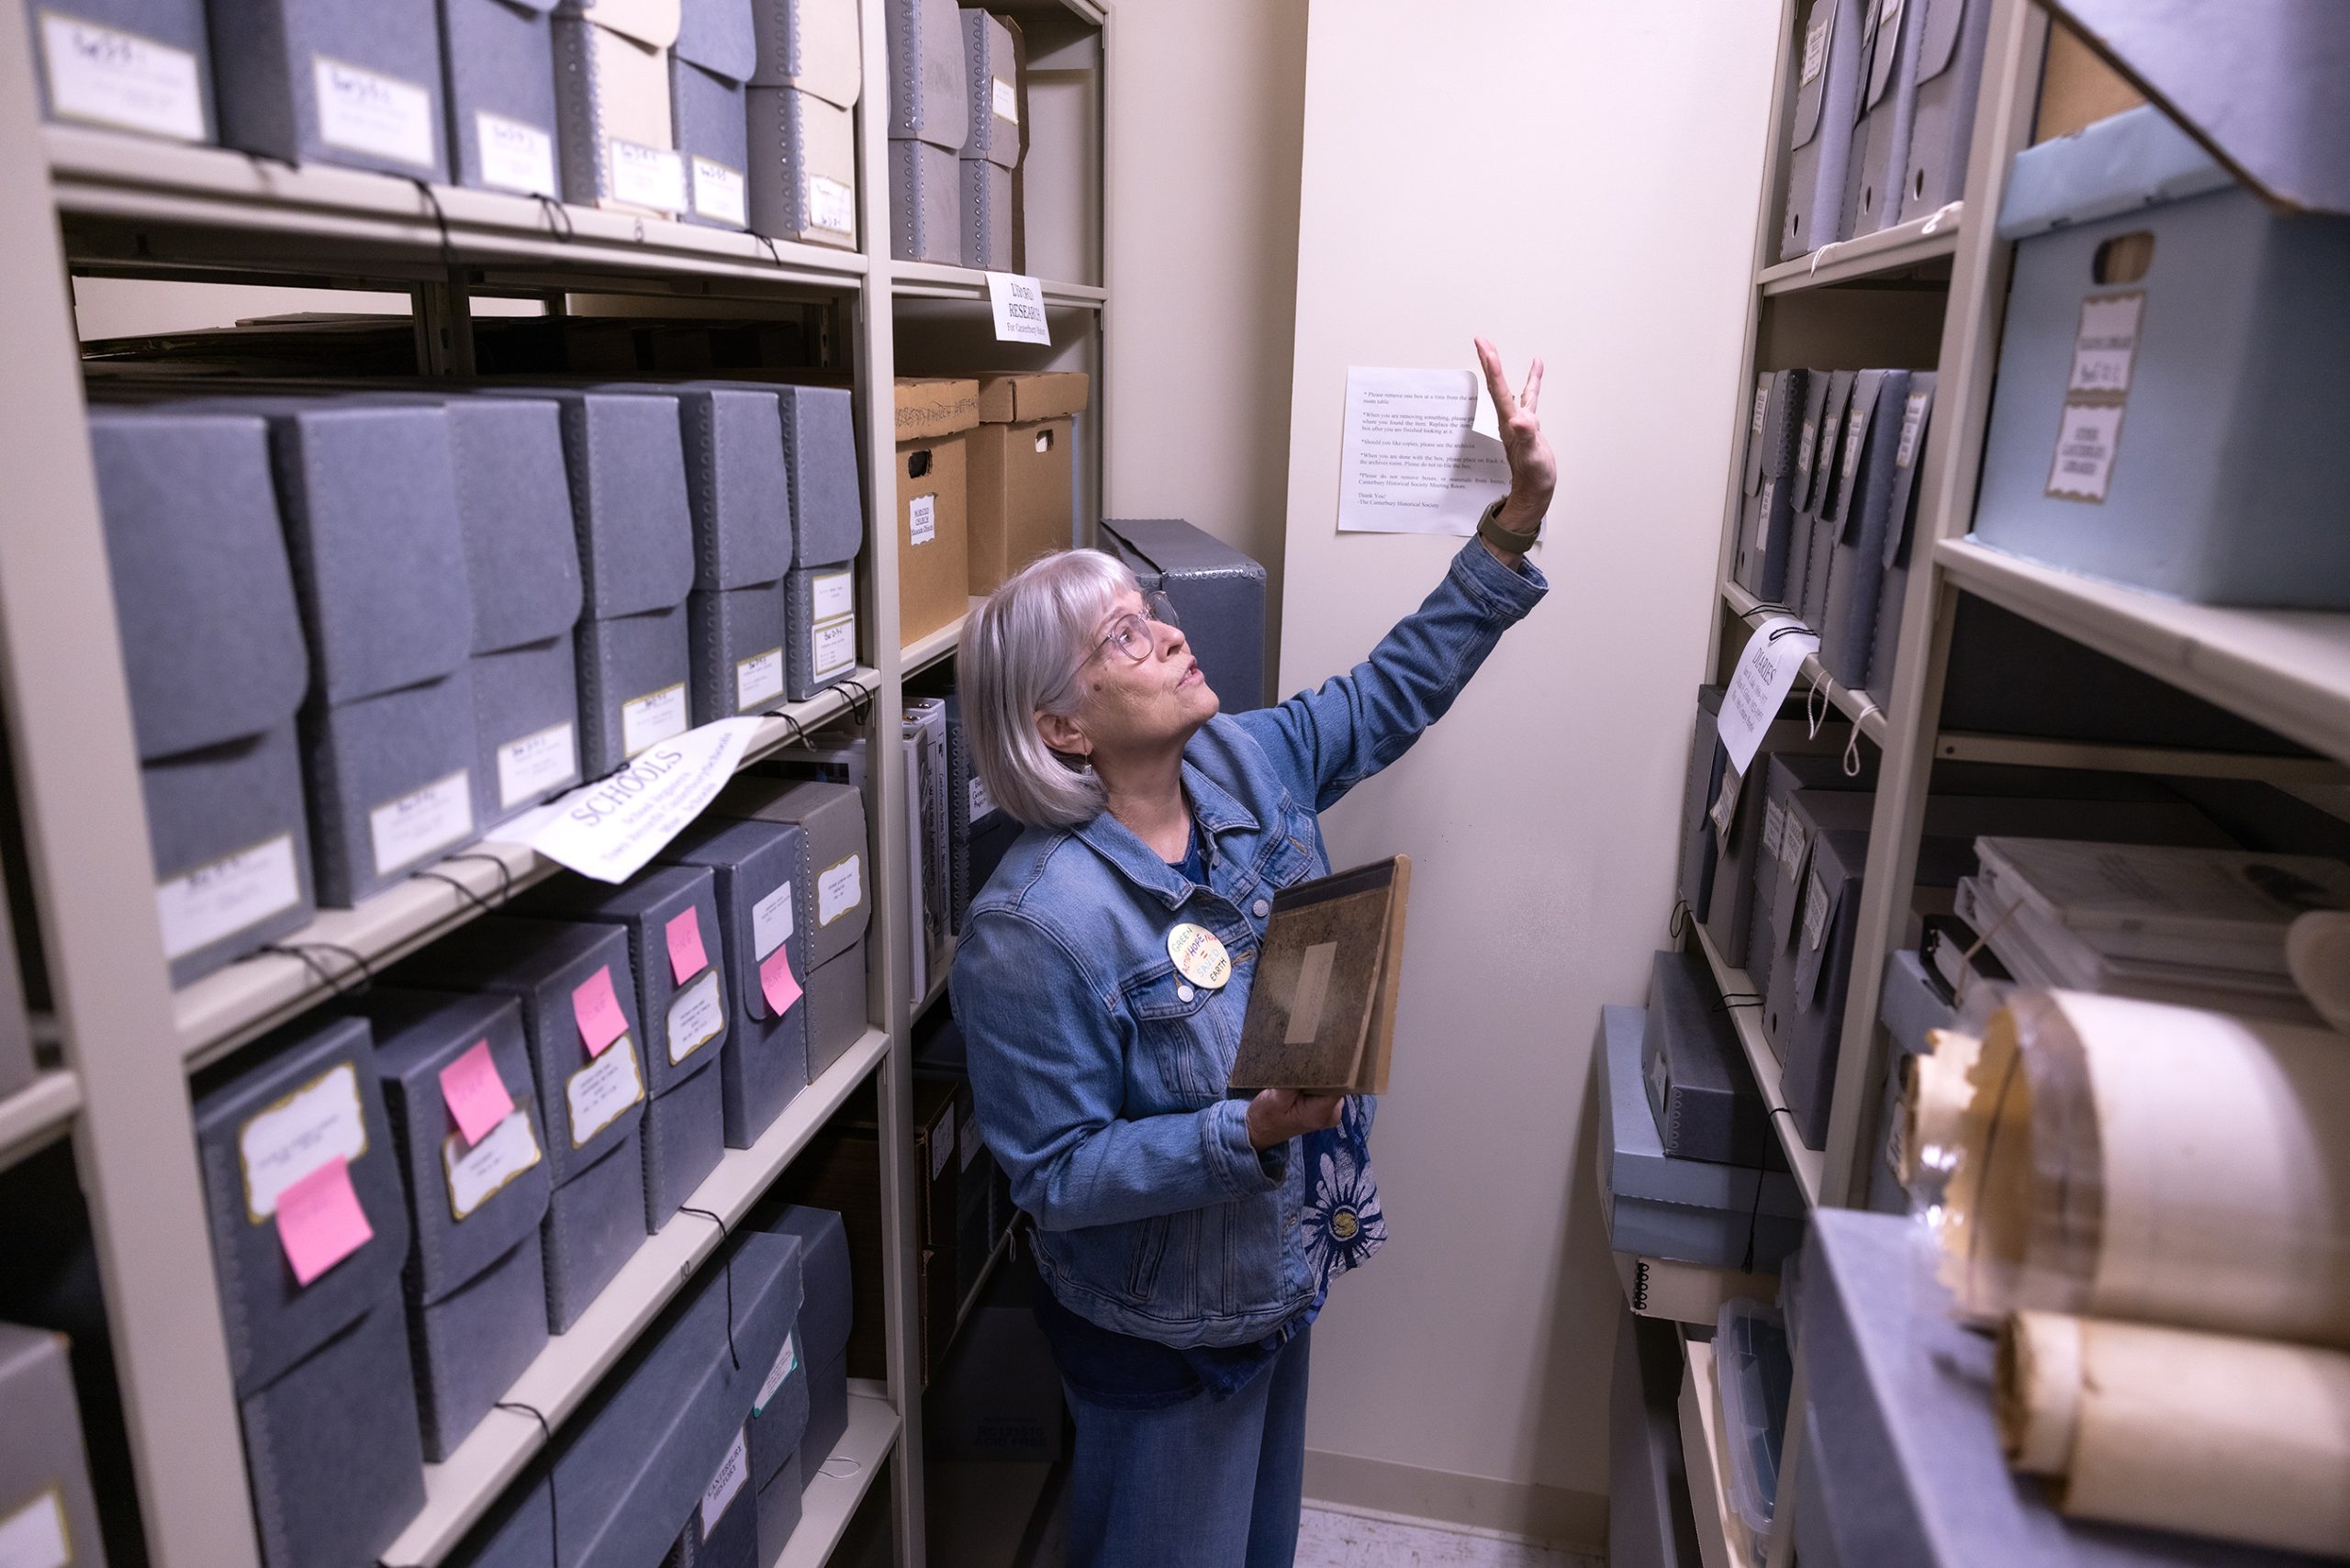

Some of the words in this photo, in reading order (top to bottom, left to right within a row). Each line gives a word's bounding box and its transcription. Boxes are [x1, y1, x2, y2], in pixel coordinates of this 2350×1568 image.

[1009, 303, 1042, 321] RESEARCH
[1752, 647, 1777, 686] DIARIES
[571, 751, 682, 827] SCHOOLS
[1171, 927, 1193, 953] GREEN
[1189, 933, 1205, 957] HOPE
[1209, 957, 1227, 982] EARTH
[713, 1464, 735, 1500] HISTORY
